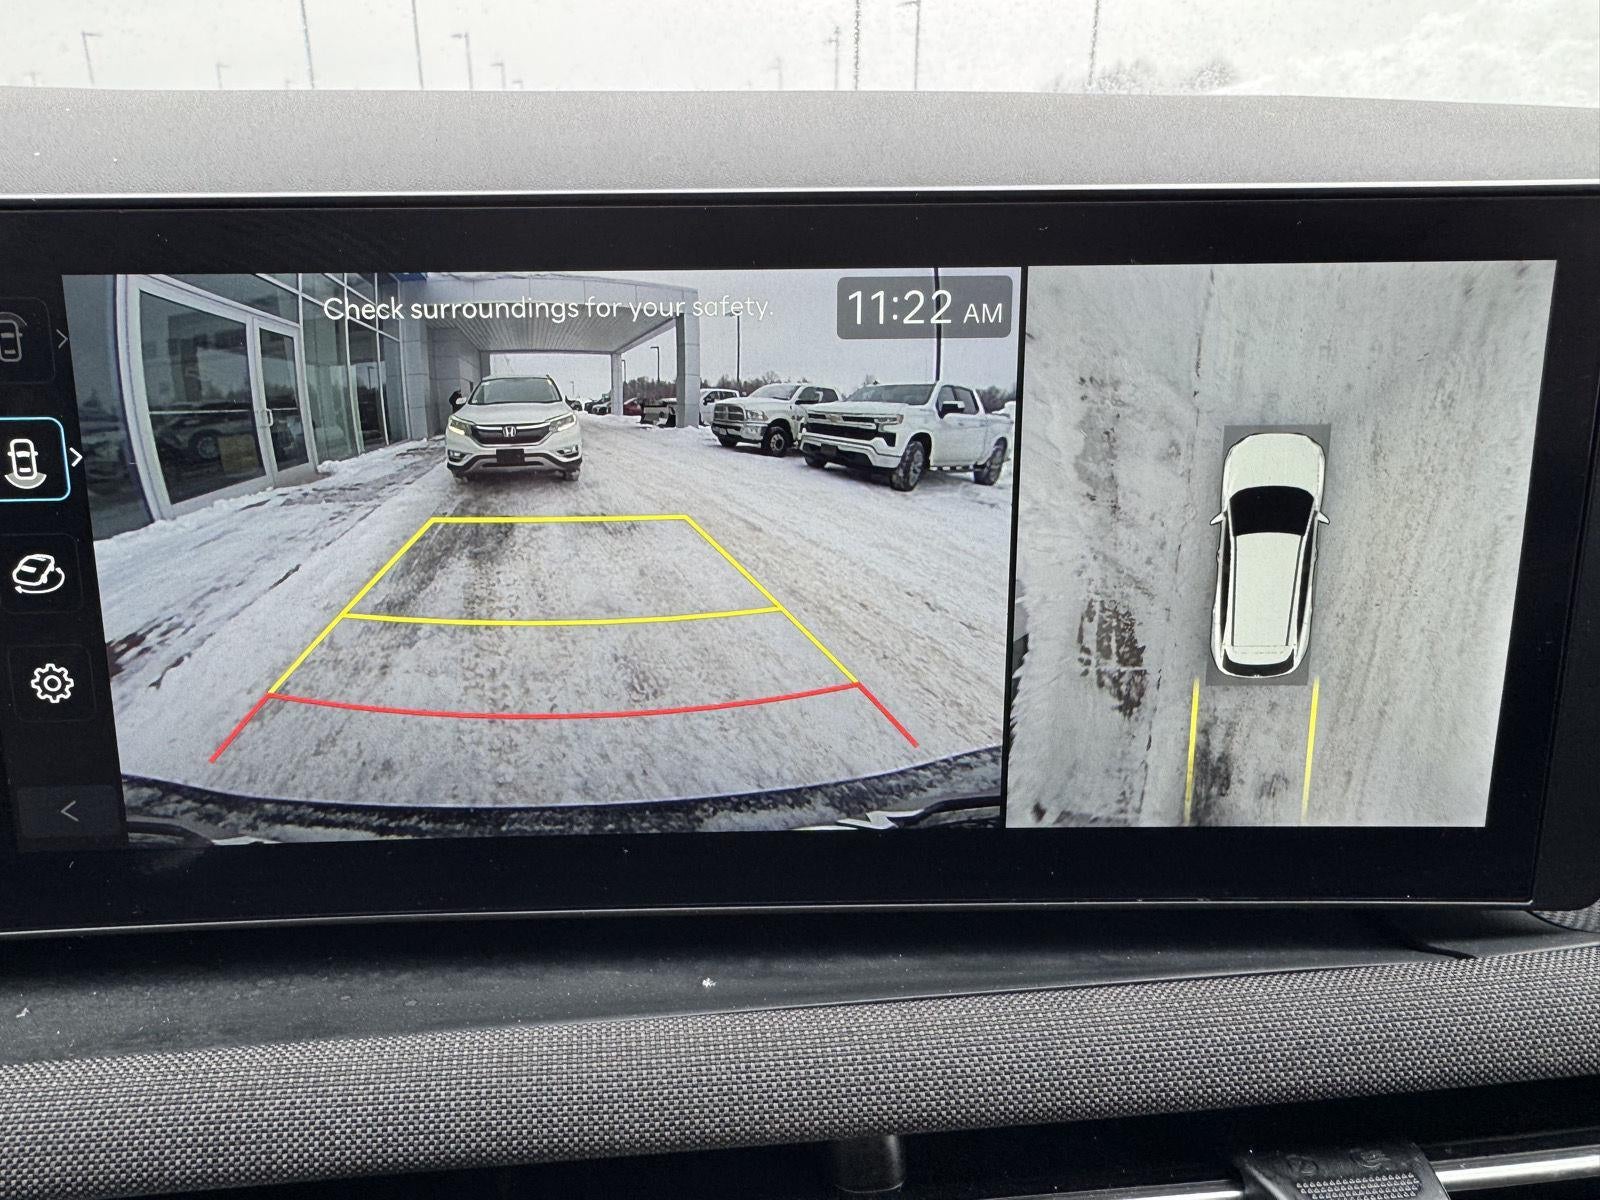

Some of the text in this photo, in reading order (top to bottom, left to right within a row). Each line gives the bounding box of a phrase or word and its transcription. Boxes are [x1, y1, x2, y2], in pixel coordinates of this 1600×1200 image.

[323, 295, 774, 323] Check surroundings for your safety.
[848, 289, 1003, 325] 11:22 AM
